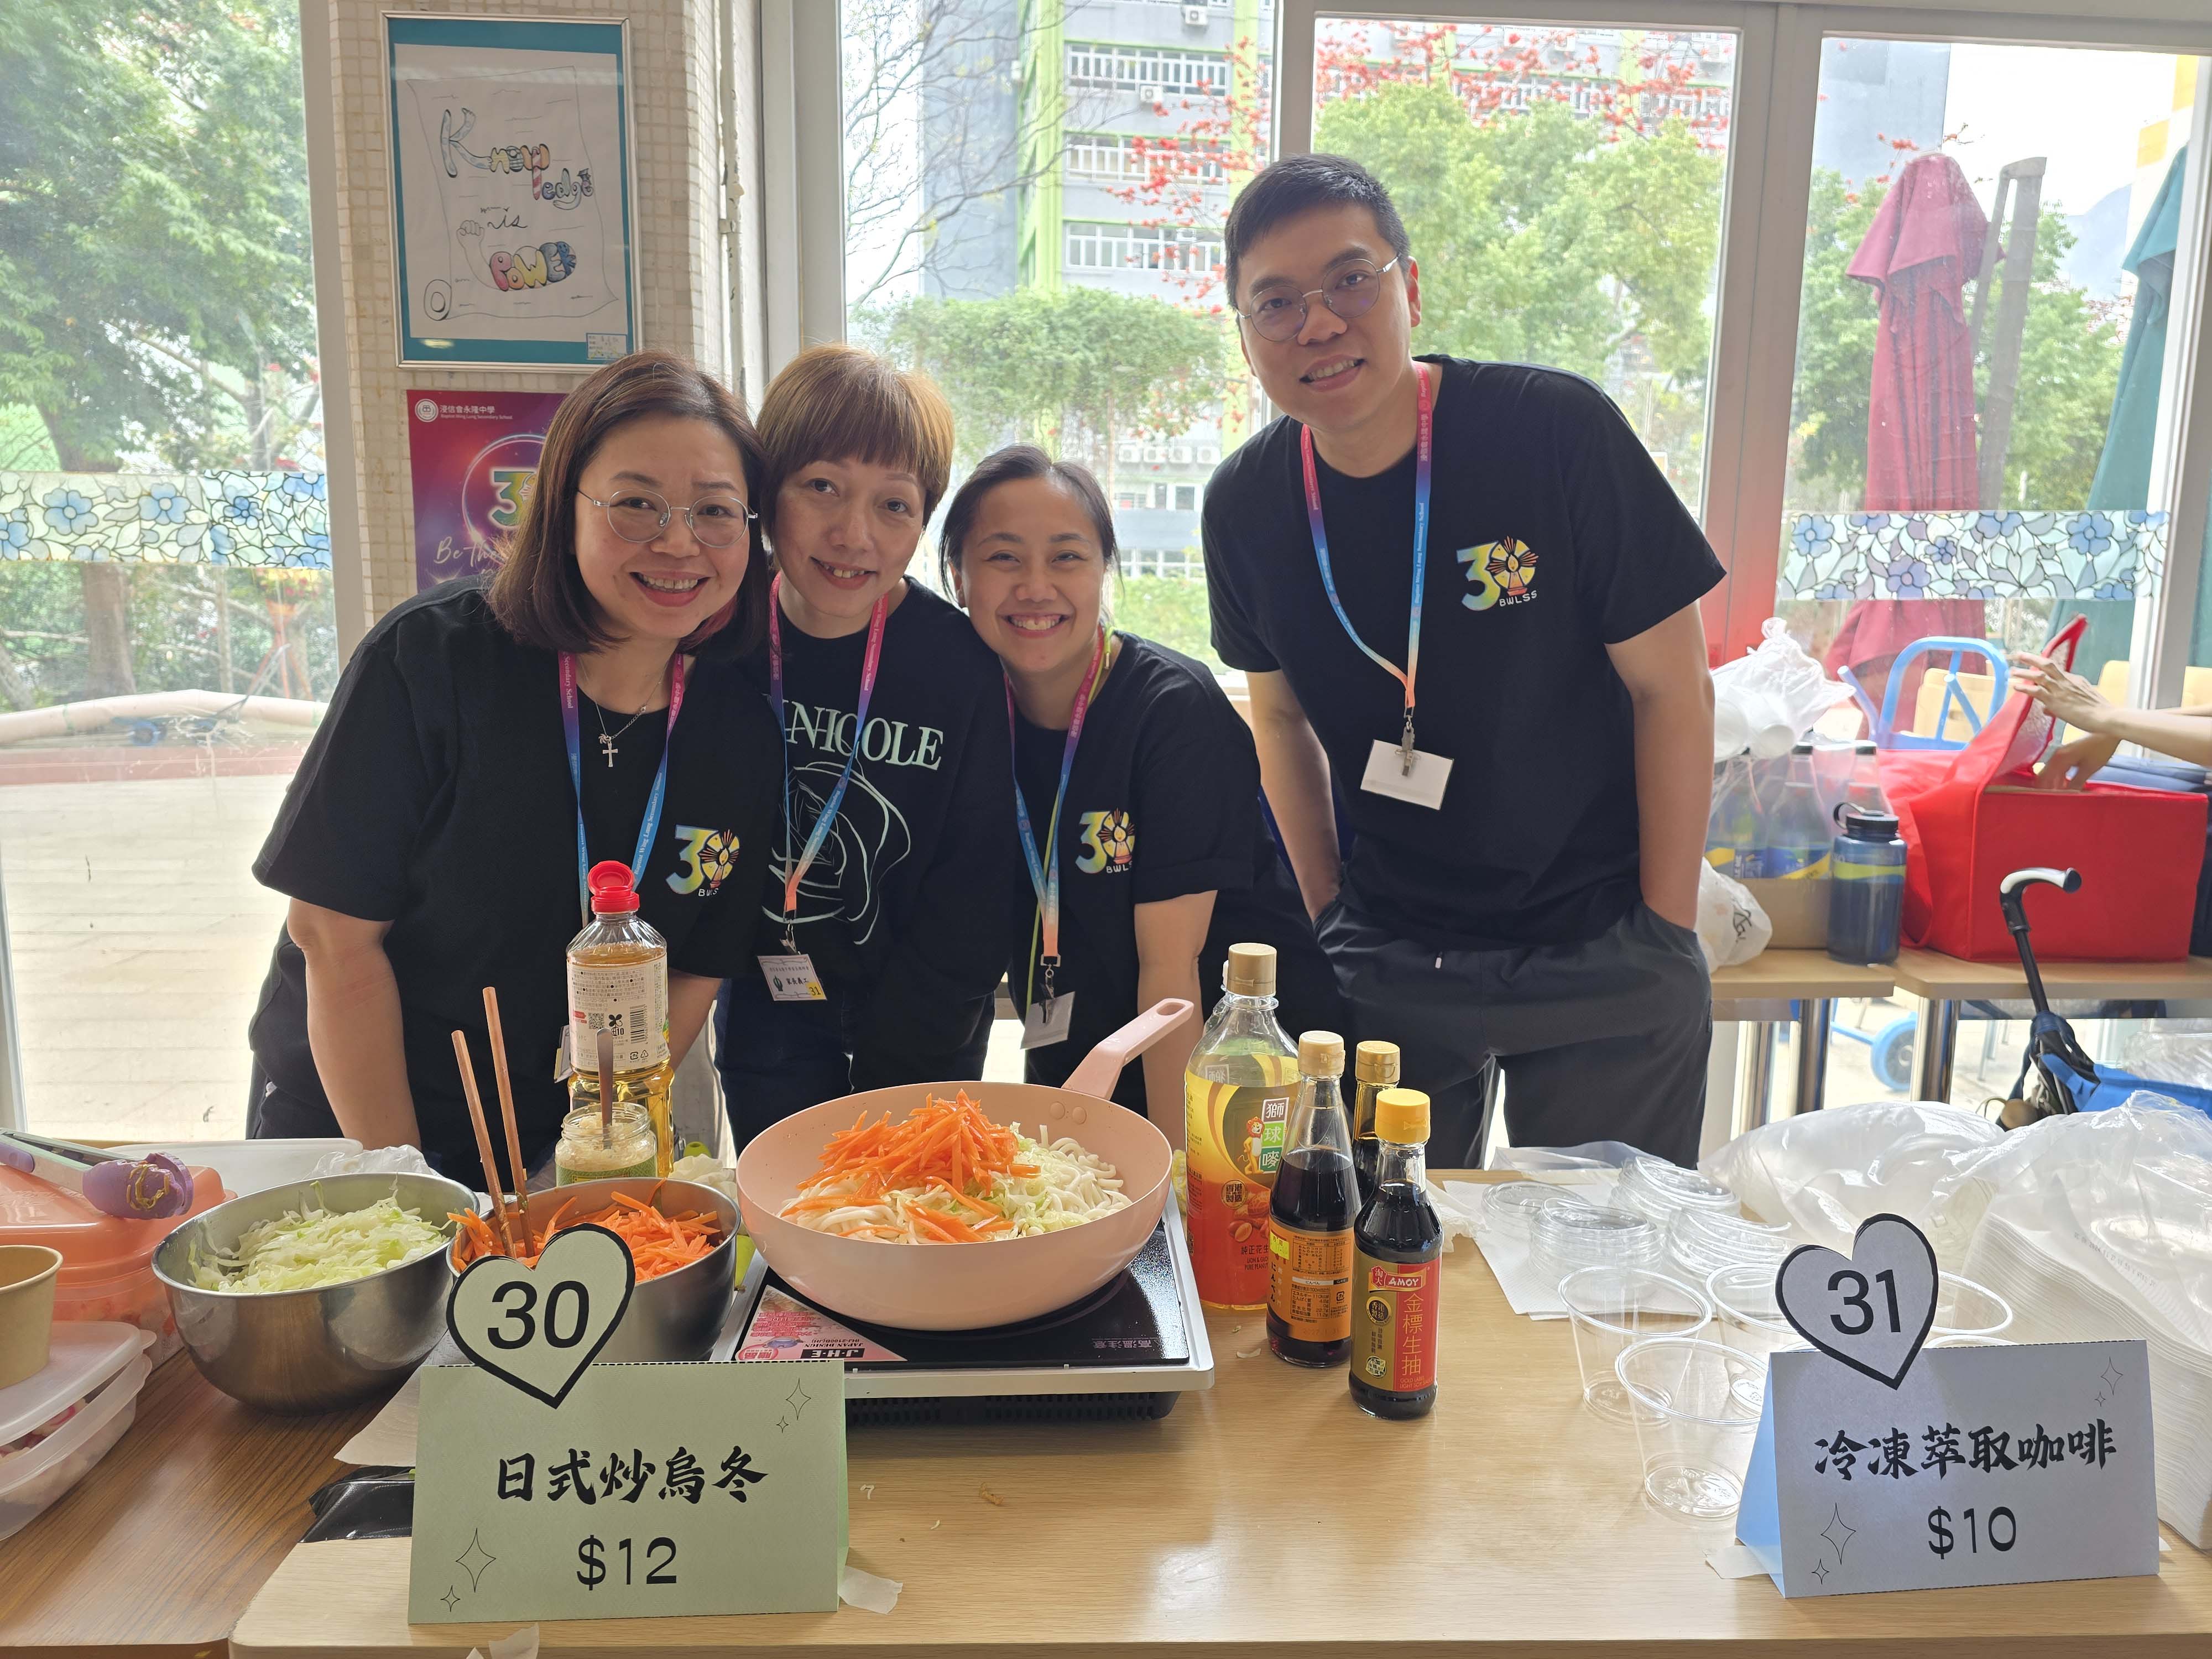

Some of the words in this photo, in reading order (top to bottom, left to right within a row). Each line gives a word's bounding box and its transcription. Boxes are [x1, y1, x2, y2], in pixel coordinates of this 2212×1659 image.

[489, 468, 536, 526] 3
[434, 536, 463, 564] Be
[1499, 590, 1537, 607] BWLSS
[781, 699, 944, 771] NICOLE
[809, 986, 821, 996] 31
[1388, 1277, 1418, 1287] AMOY
[1827, 1269, 1901, 1335] 31
[487, 1281, 590, 1349] 30
[1402, 1293, 1425, 1376] 金標生抽
[1092, 1340, 1152, 1348] 高溫注意
[498, 1445, 769, 1505] 日式炒烏冬
[1814, 1418, 2116, 1481] 冷凍萃取咖啡
[1928, 1505, 2016, 1559] $10
[576, 1535, 677, 1590] $12
